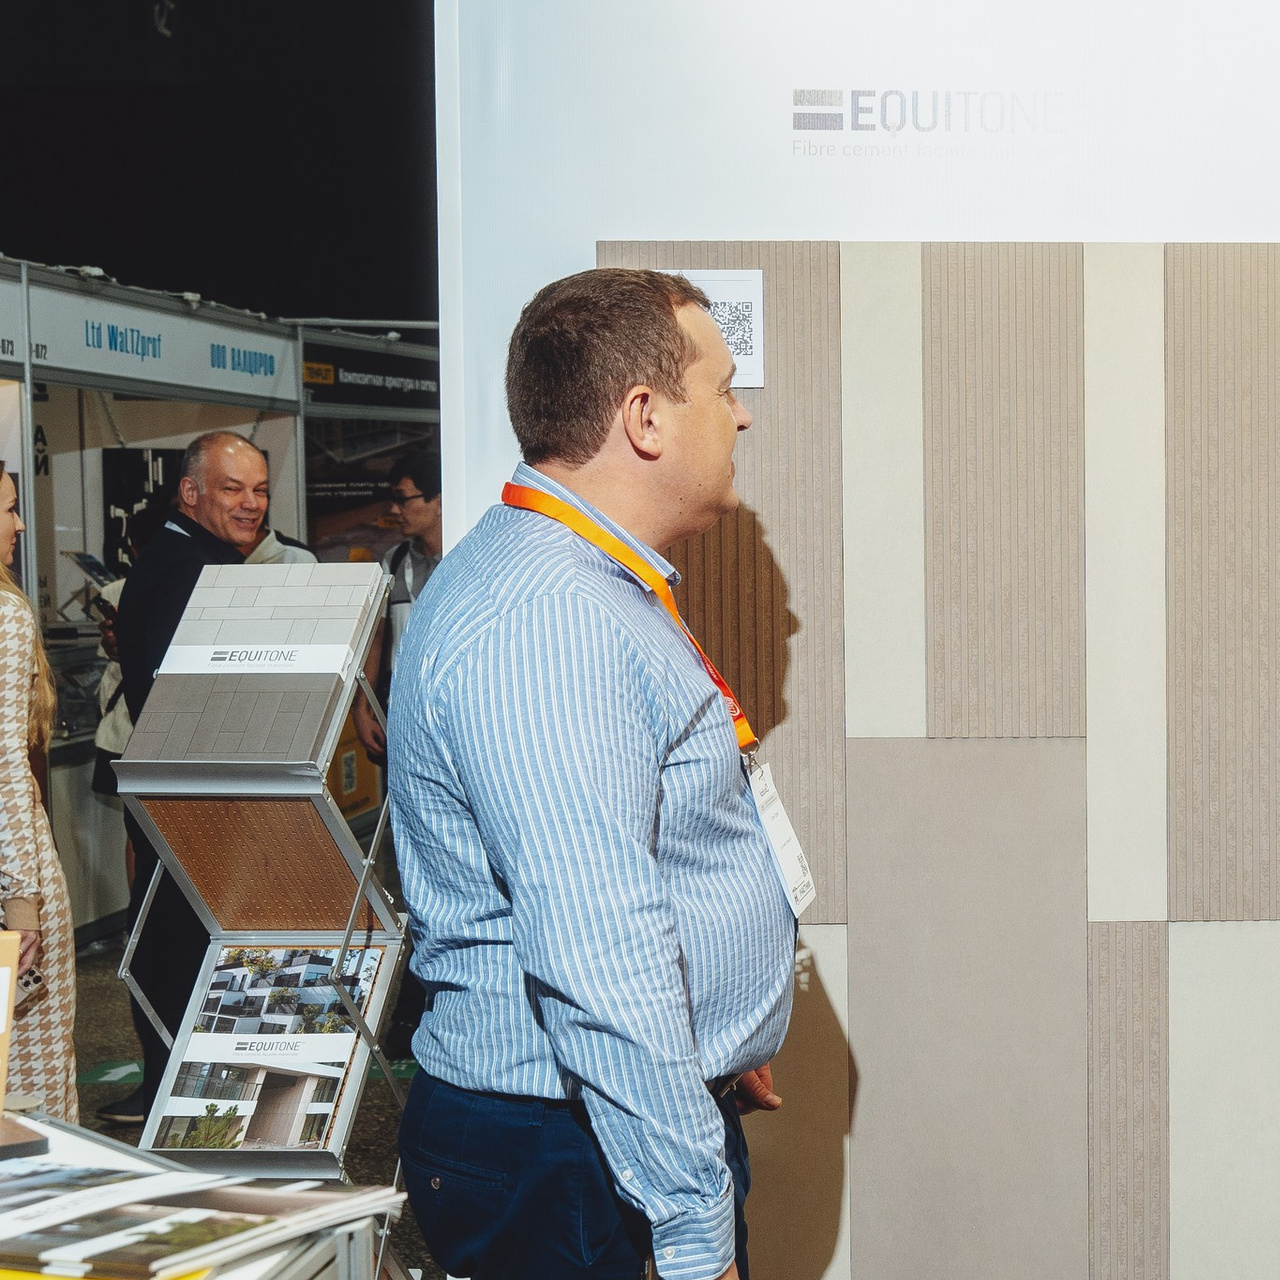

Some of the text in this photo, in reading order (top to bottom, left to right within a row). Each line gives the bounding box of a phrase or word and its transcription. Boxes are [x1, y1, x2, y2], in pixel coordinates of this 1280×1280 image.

[85, 320, 102, 349] Ltd
[228, 650, 299, 662] EQUITONE
[248, 1041, 301, 1052] EQUITONE
